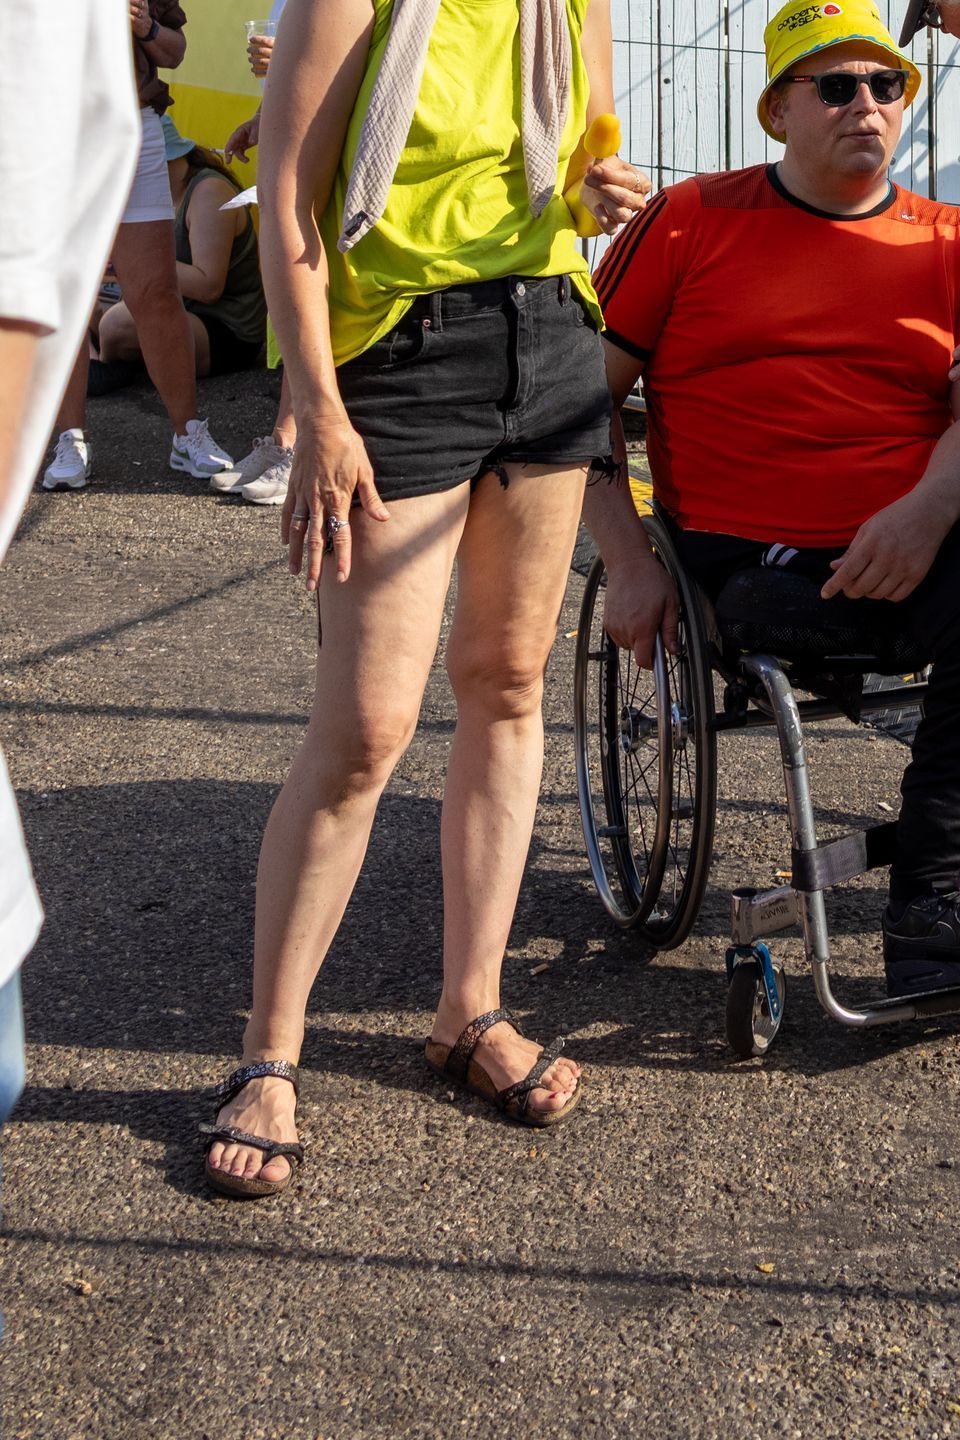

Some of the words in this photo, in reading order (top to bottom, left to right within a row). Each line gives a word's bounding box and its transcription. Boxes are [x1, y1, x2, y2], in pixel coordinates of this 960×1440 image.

[778, 5, 820, 32] concert
[789, 22, 799, 32] at
[799, 13, 822, 27] SEA
